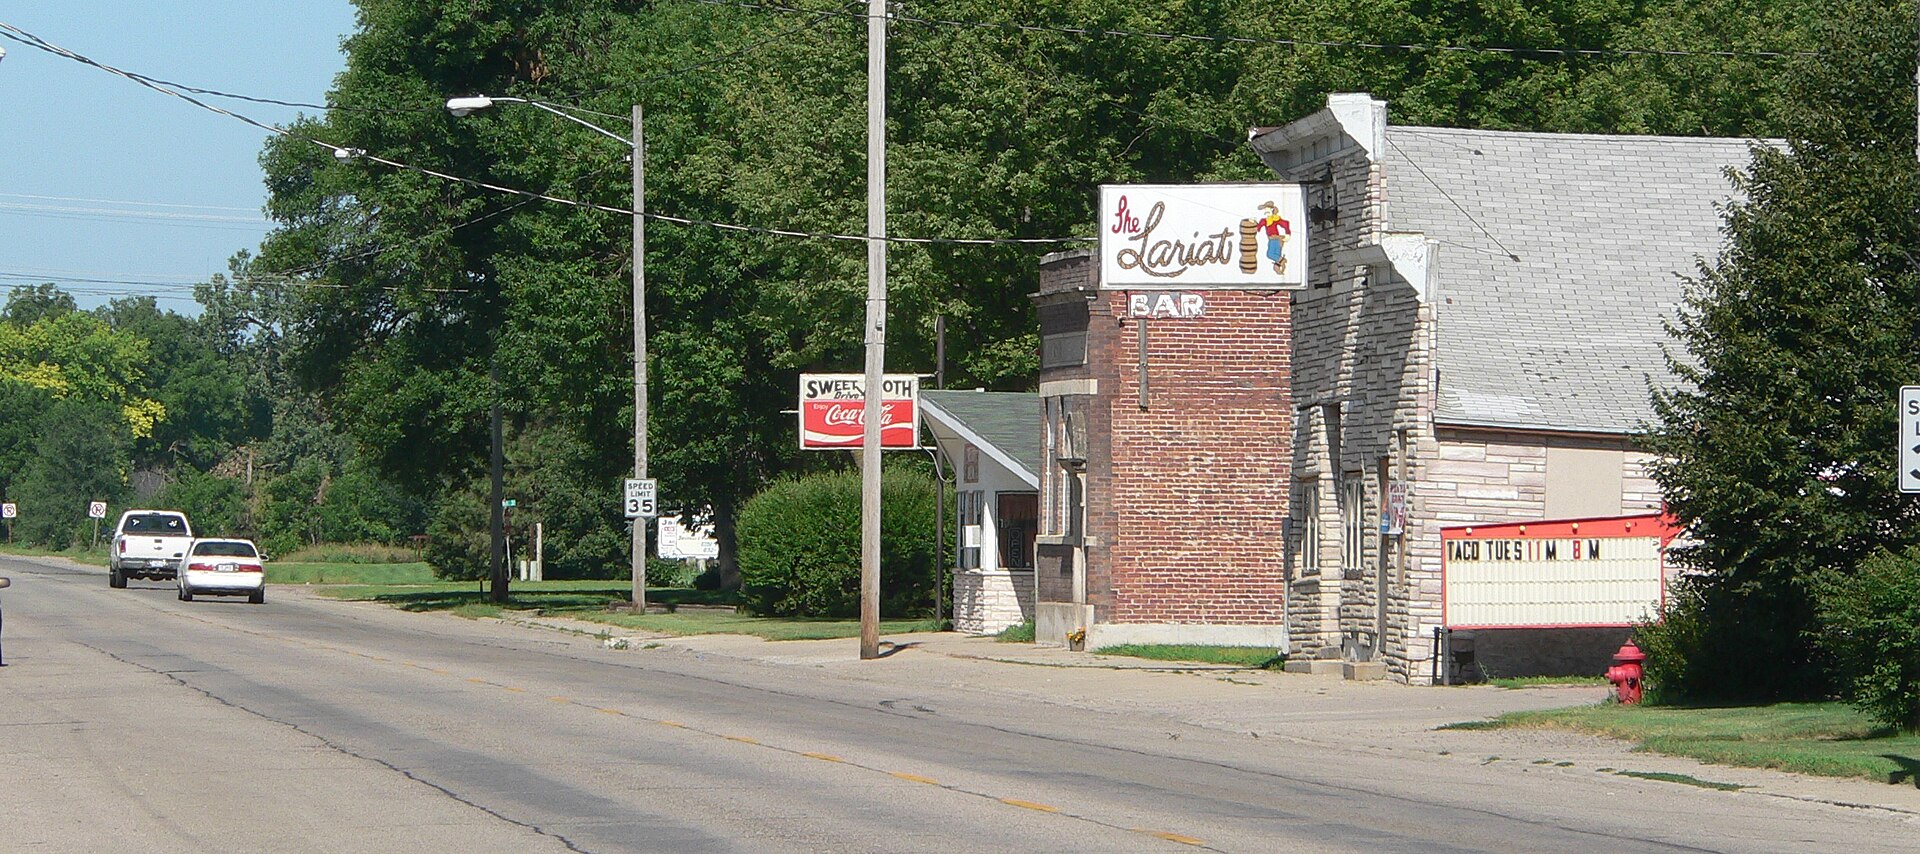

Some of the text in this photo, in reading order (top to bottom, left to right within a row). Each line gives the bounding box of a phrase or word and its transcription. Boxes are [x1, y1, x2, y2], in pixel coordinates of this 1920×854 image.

[1112, 195, 1142, 234] The
[1117, 201, 1235, 278] Lariat
[1130, 294, 1206, 319] BAR
[806, 380, 858, 398] SWEET
[813, 403, 829, 411] Enjoy
[628, 482, 653, 490] SPEED
[628, 499, 653, 513] 35
[1446, 541, 1480, 561] TACO
[1485, 541, 1522, 561] TUES
